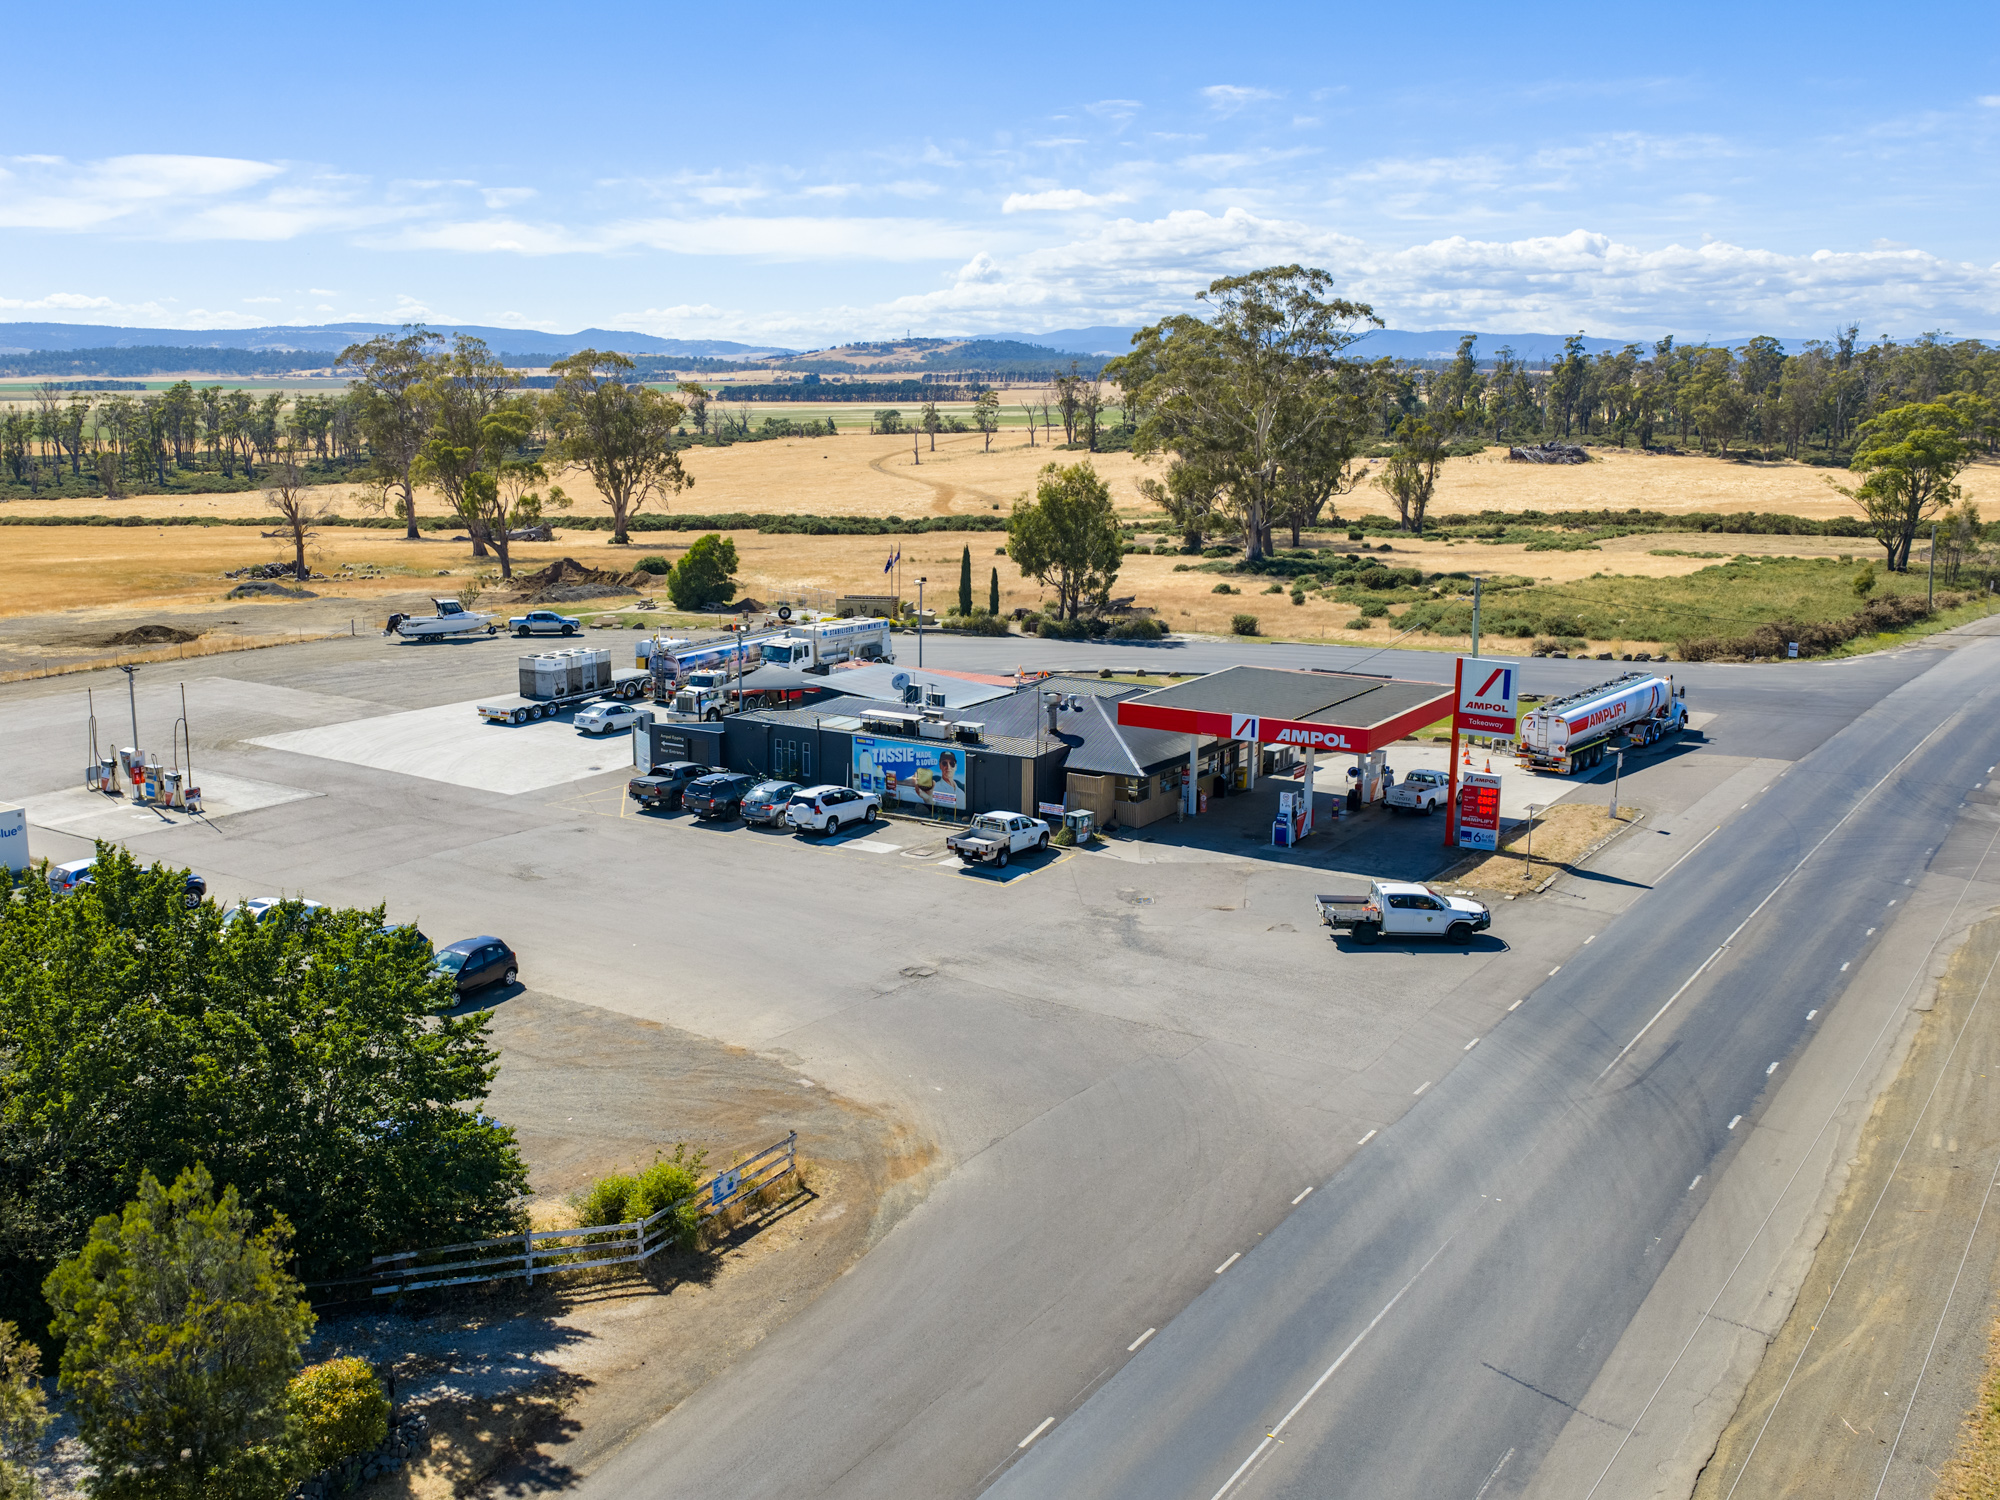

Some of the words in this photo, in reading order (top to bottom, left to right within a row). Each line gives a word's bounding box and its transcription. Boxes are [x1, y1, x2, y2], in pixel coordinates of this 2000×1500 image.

[1465, 701, 1509, 713] AMPOL
[1589, 701, 1627, 728] AMPLIFY
[1468, 718, 1504, 729] Takeaway
[1275, 728, 1351, 748] AMPOL
[872, 747, 914, 763] TASSIE
[916, 751, 932, 759] MADE
[1467, 816, 1494, 825] AMPLIFY
[1473, 832, 1482, 843] 6
